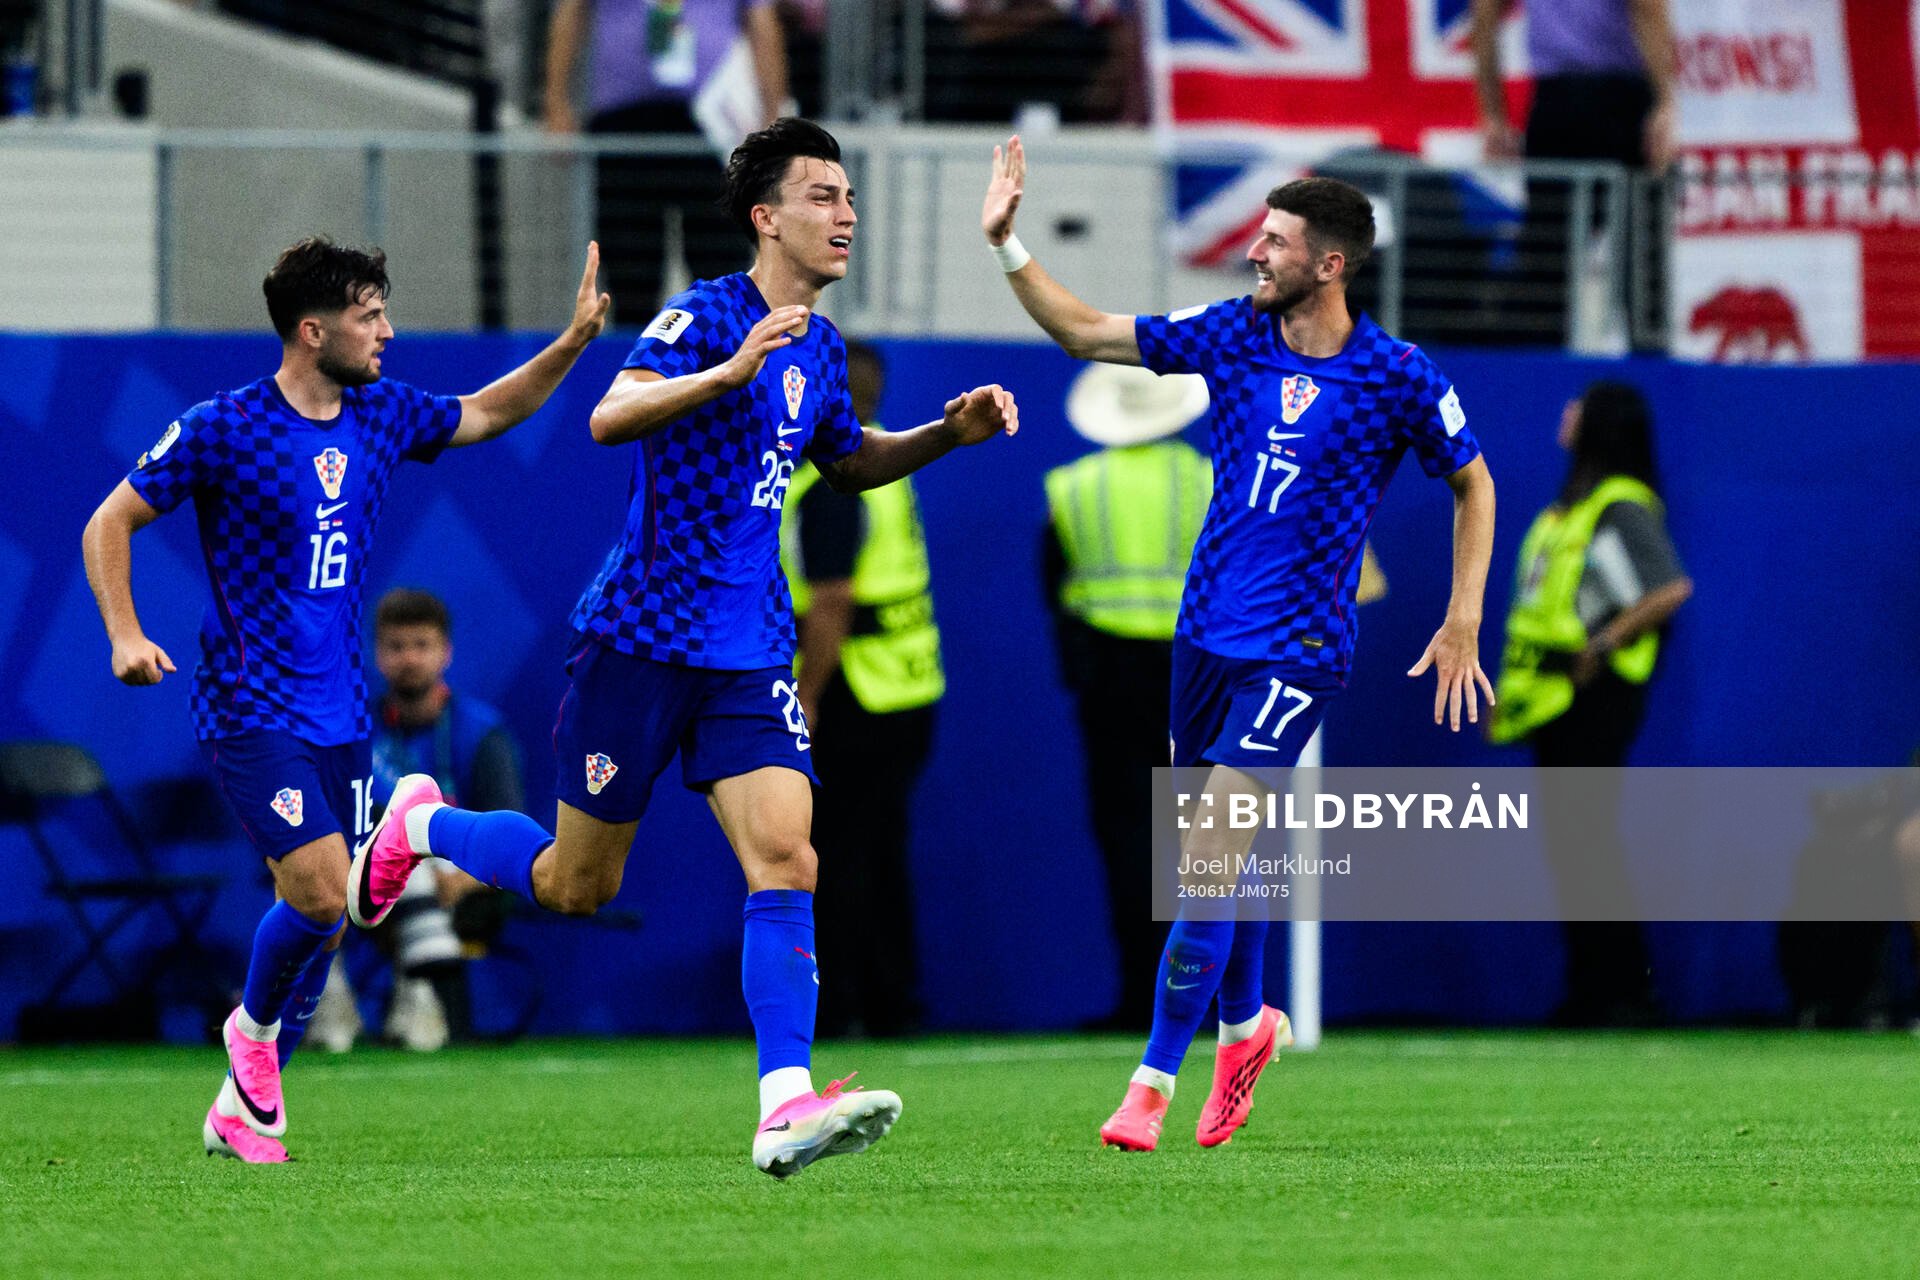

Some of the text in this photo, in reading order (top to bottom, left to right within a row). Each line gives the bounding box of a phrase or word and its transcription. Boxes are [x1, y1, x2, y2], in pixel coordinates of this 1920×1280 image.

[1803, 151, 1920, 225] FRA
[1248, 452, 1301, 513] 17
[309, 531, 348, 589] 16
[1253, 677, 1313, 739] 17
